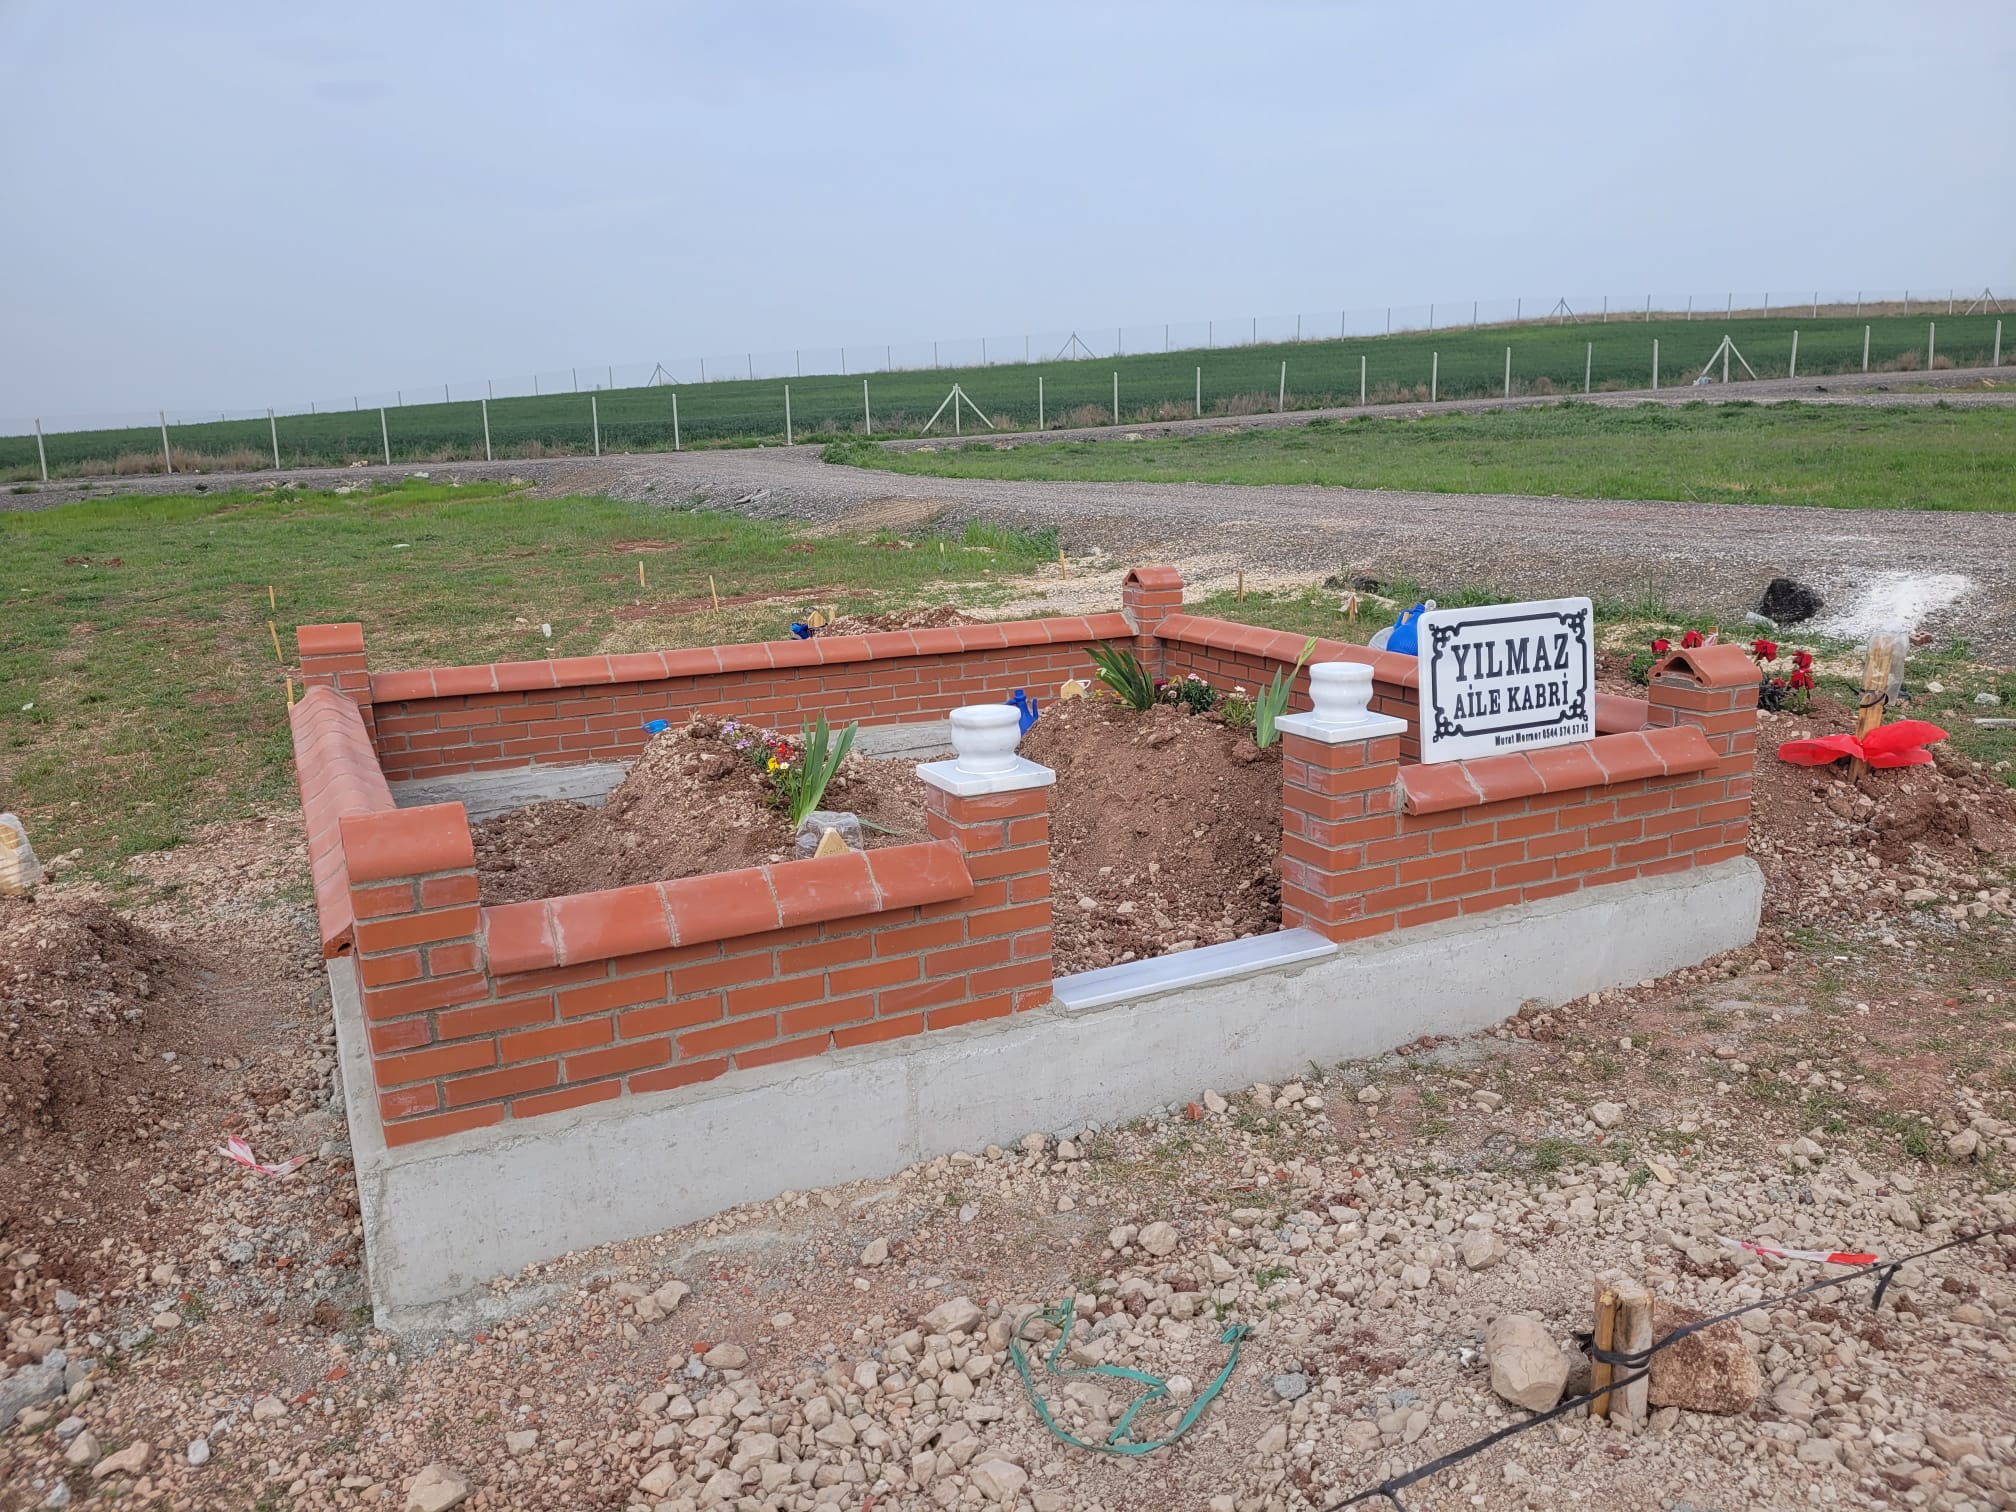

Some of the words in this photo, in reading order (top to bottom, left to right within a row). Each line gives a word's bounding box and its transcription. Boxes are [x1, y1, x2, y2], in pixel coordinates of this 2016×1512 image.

[1451, 632, 1569, 682] YILMAZ
[1453, 684, 1501, 720] AİLE
[1507, 672, 1569, 713] KABRİ
[1495, 733, 1514, 746] Murat
[1542, 727, 1558, 739] 0544
